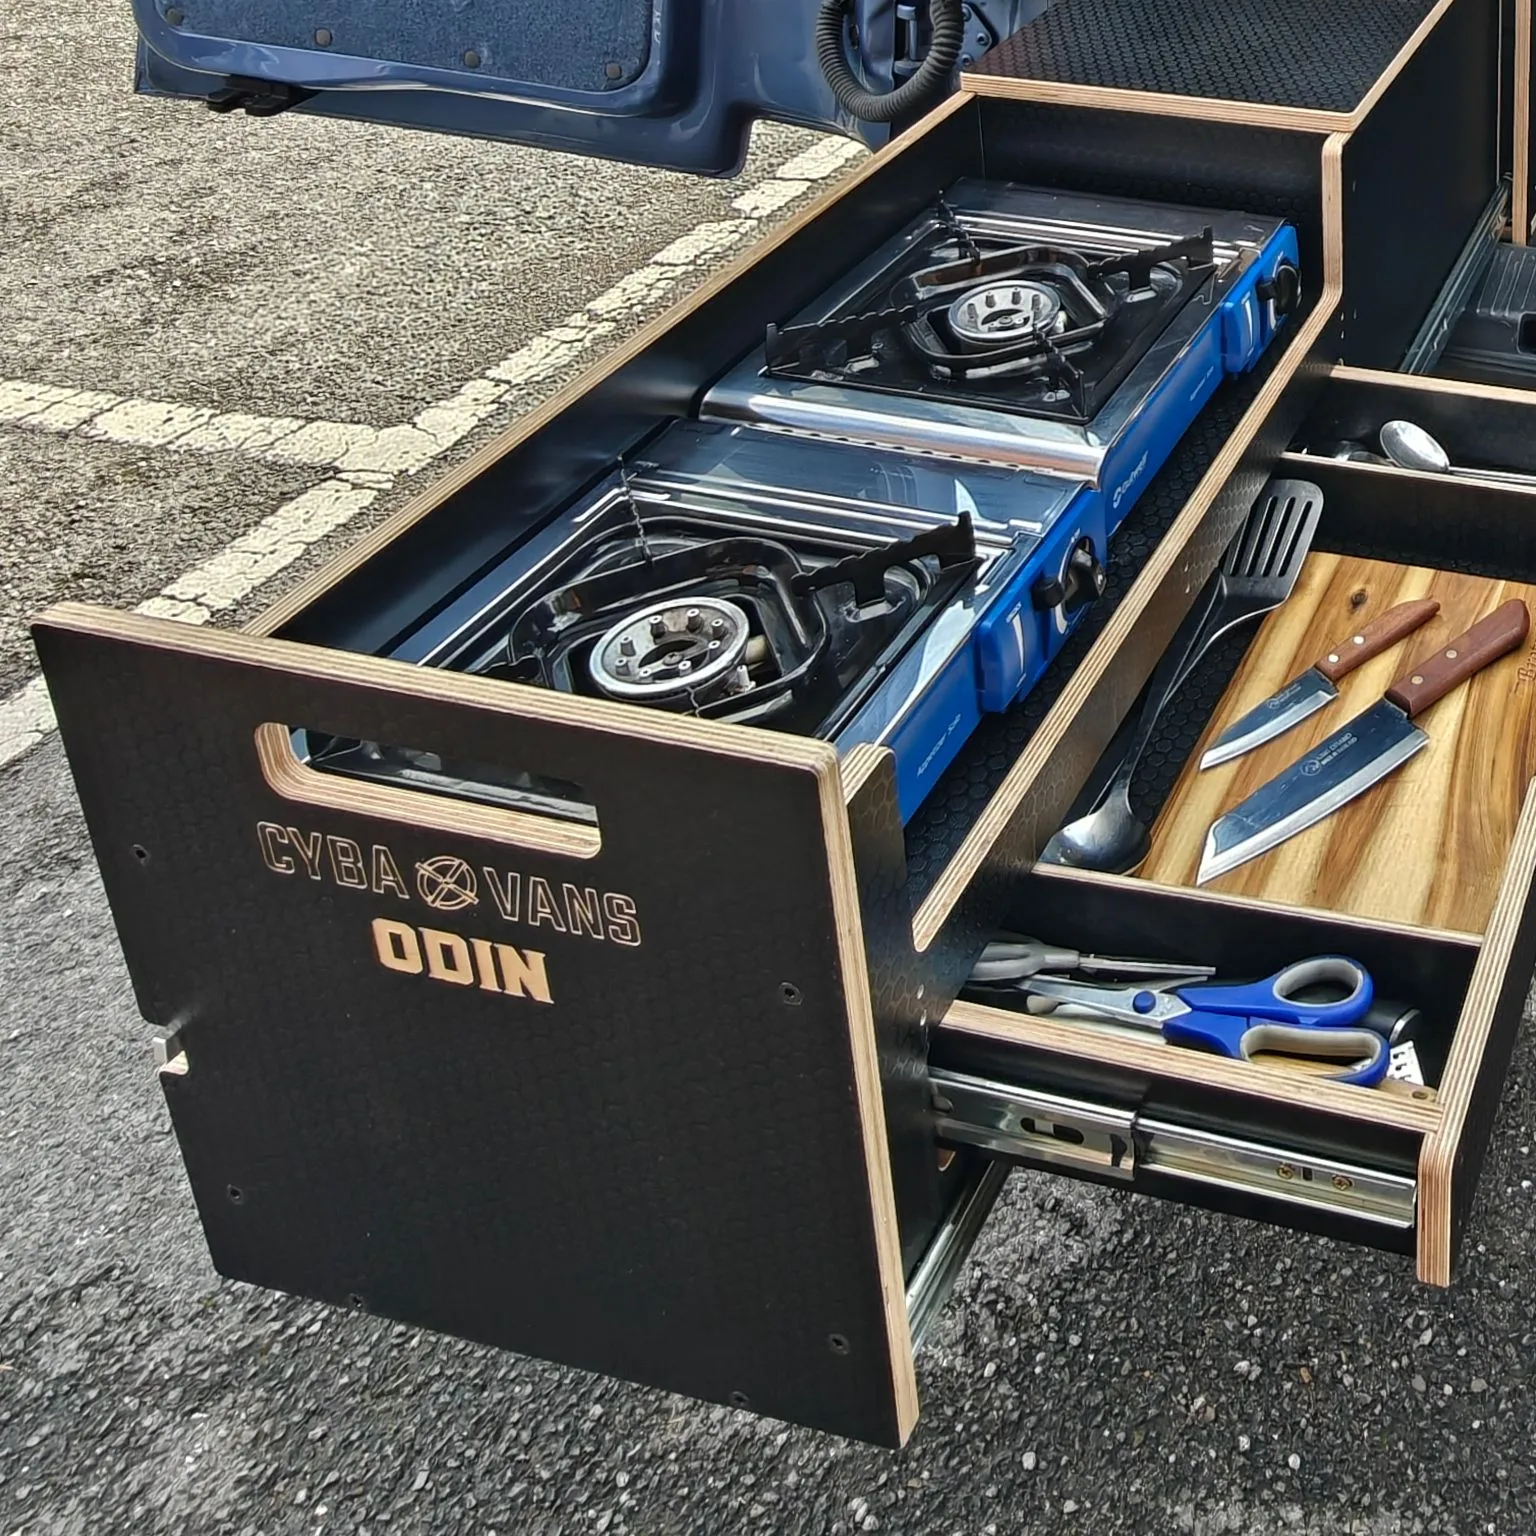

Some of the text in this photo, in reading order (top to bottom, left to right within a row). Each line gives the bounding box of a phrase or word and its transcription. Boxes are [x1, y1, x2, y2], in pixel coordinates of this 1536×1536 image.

[256, 820, 642, 947] CYBA VANS
[371, 917, 555, 1005] ODIN
